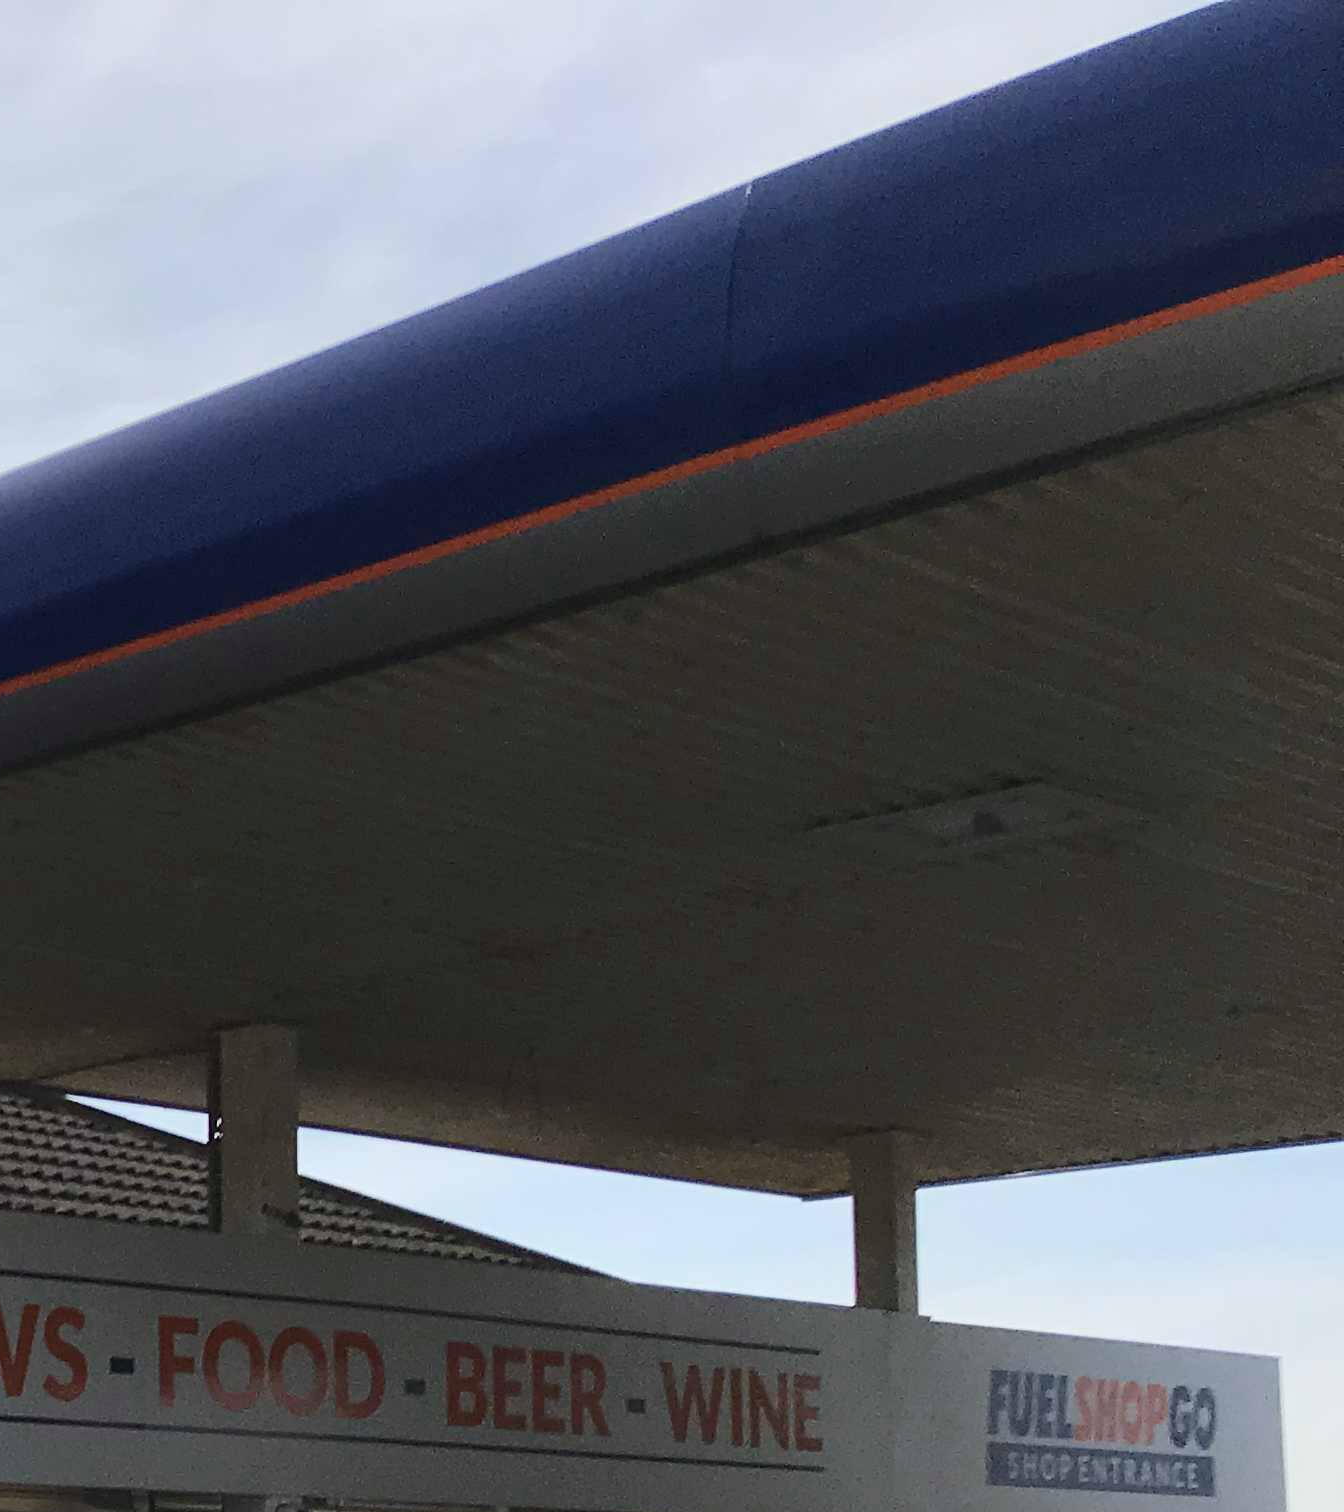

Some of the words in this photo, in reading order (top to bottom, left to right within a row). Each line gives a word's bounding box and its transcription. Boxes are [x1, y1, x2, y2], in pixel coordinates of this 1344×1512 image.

[156, 1315, 387, 1421] FOOD
[444, 1340, 611, 1438] BEER
[660, 1360, 825, 1454] WINE
[1007, 1450, 1072, 1483] SHOP
[1077, 1454, 1201, 1491] ENTRANCE
